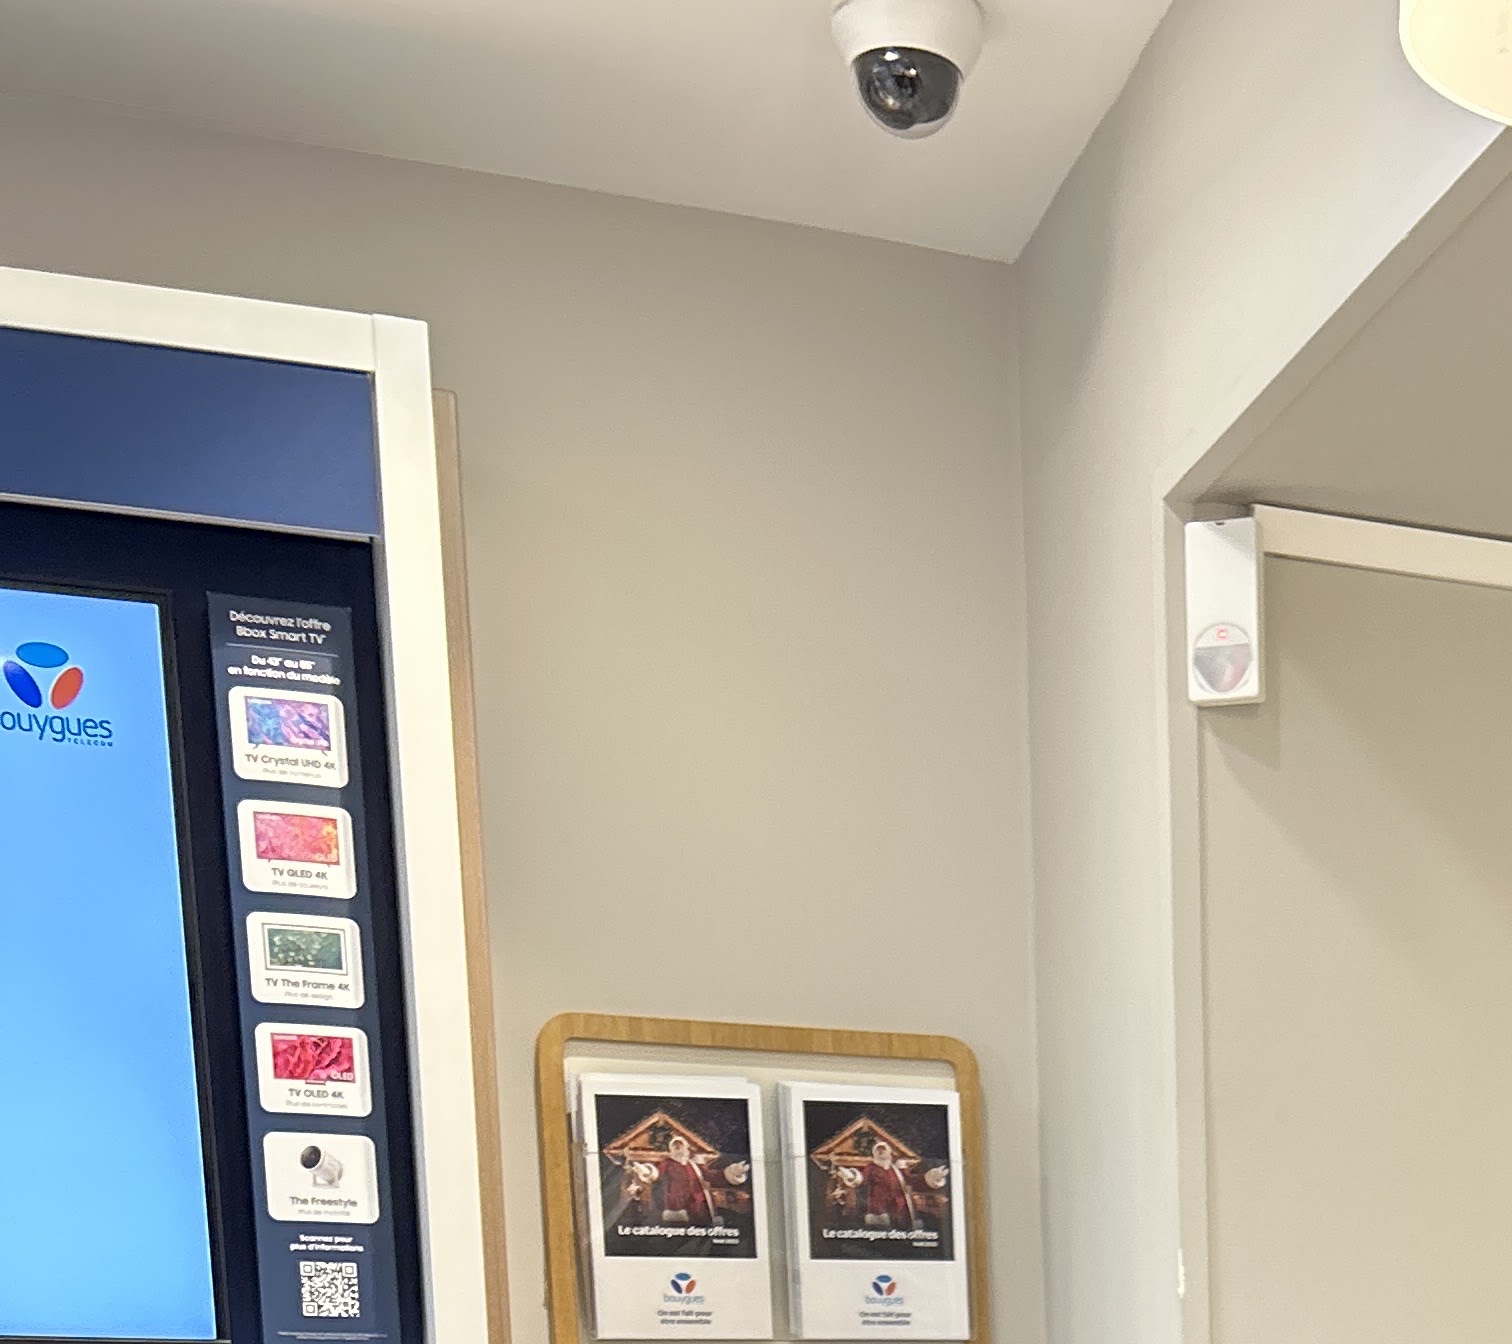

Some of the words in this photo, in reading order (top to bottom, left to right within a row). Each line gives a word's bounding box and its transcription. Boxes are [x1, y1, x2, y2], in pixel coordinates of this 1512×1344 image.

[229, 610, 294, 628] Découvrez
[296, 617, 332, 632] l'offre
[236, 625, 267, 639] Bbox
[269, 629, 306, 643] Smart
[227, 666, 242, 676] en
[243, 665, 286, 679] fonction
[286, 671, 301, 680] du
[302, 673, 341, 686] modèle
[0, 711, 113, 743] ouygues
[245, 754, 258, 764] TV
[261, 755, 299, 768] Crystal
[301, 759, 321, 769] UHD
[324, 761, 337, 770] 4K
[272, 868, 284, 877] TV
[287, 869, 313, 879] QLED
[315, 871, 328, 880] 4K
[265, 978, 277, 987] TV
[281, 978, 300, 988] The
[302, 980, 336, 991] Frame
[338, 983, 350, 992] 4K
[288, 1088, 301, 1097] TV
[304, 1089, 329, 1099] OLED
[331, 1090, 344, 1099] 4K
[289, 1196, 308, 1206] The
[311, 1196, 358, 1208] Freestyle
[618, 1225, 631, 1236] Le
[632, 1225, 686, 1239] catalogue
[686, 1225, 707, 1237] des
[708, 1225, 740, 1237] offres
[822, 1228, 836, 1239] Le
[836, 1229, 887, 1241] catalogue
[888, 1229, 907, 1240] des
[907, 1229, 939, 1240] offres
